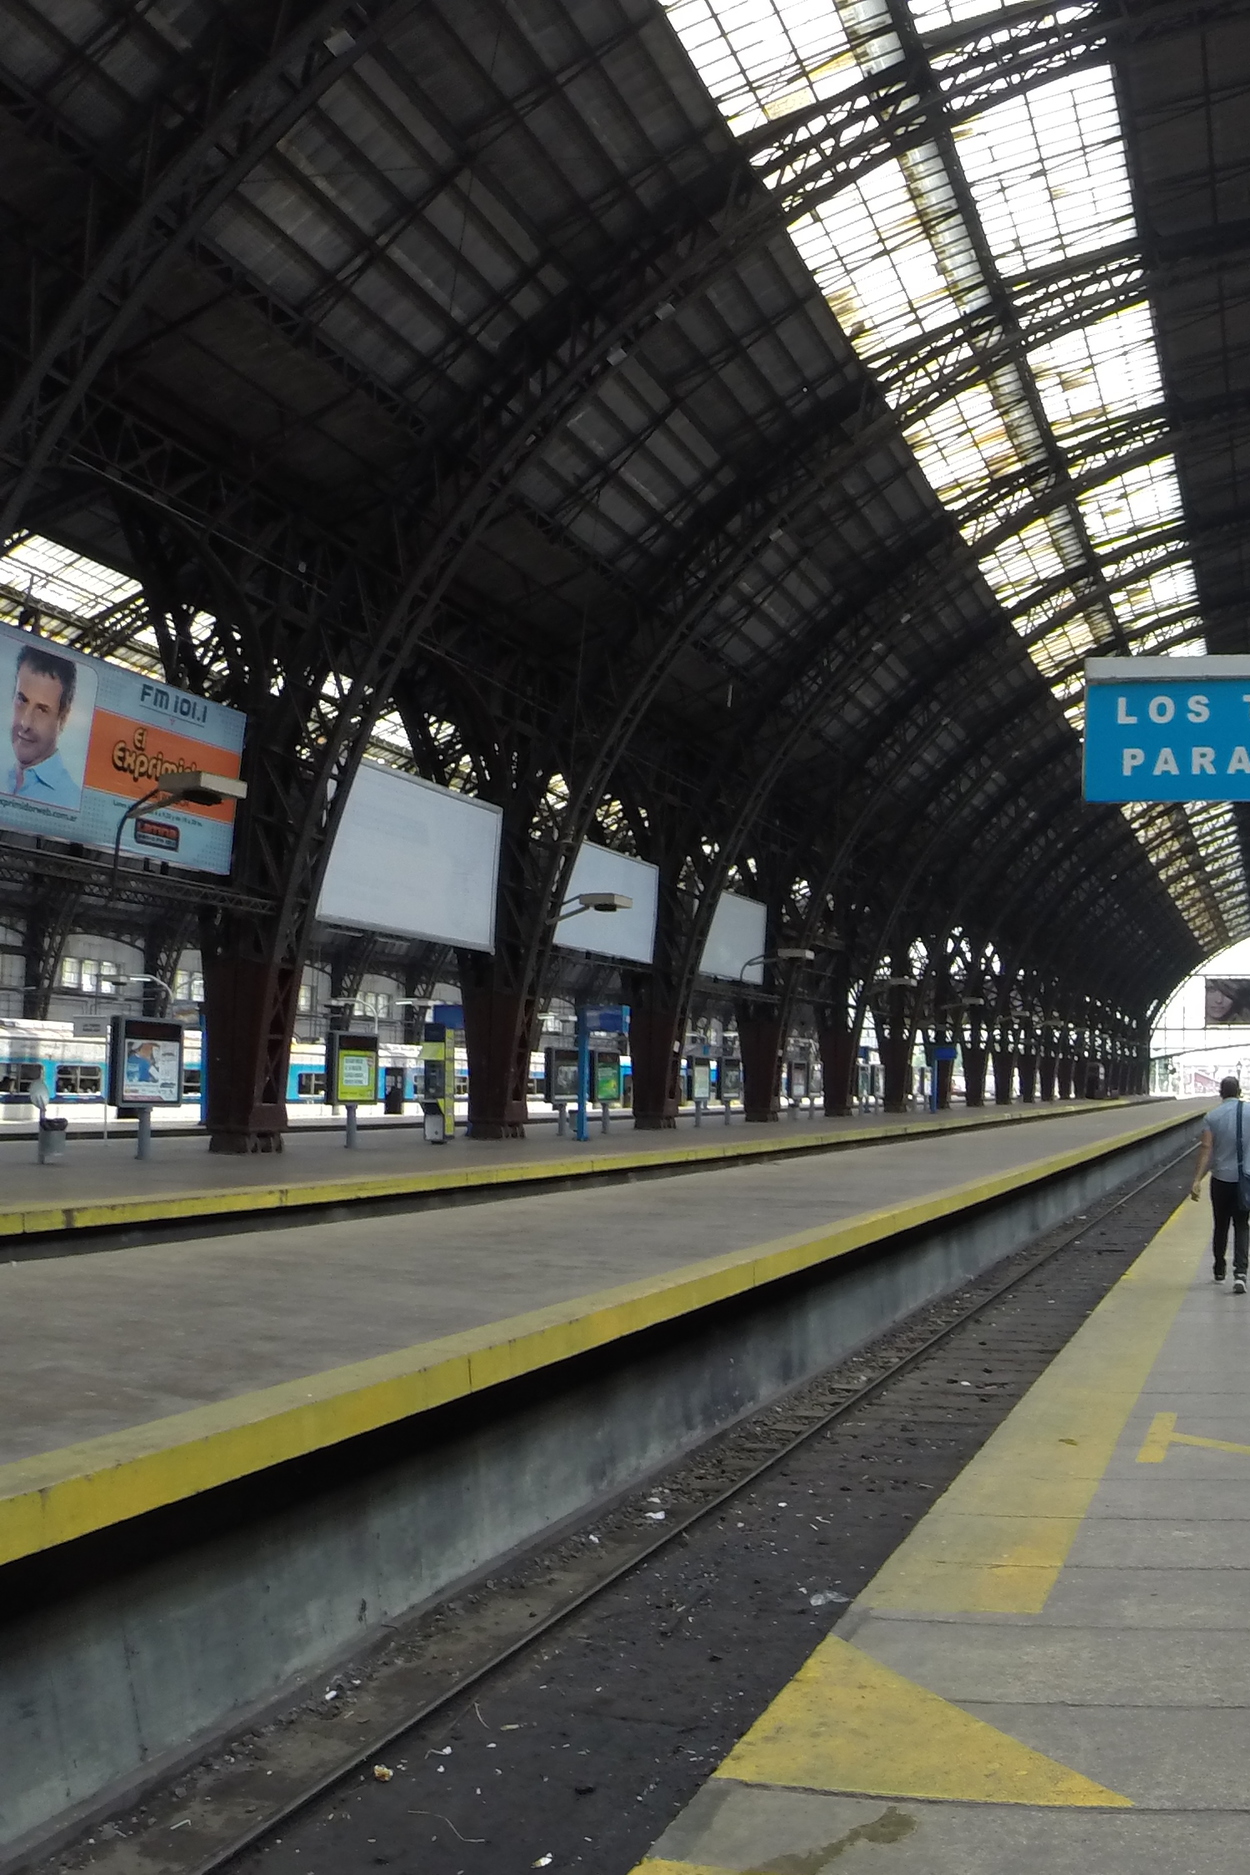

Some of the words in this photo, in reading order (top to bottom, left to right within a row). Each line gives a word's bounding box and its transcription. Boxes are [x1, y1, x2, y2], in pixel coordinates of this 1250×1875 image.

[140, 684, 170, 710] FM
[173, 694, 208, 724] 101.1
[1116, 695, 1211, 725] LOS
[133, 727, 148, 750] El
[112, 740, 201, 783] Exprimi
